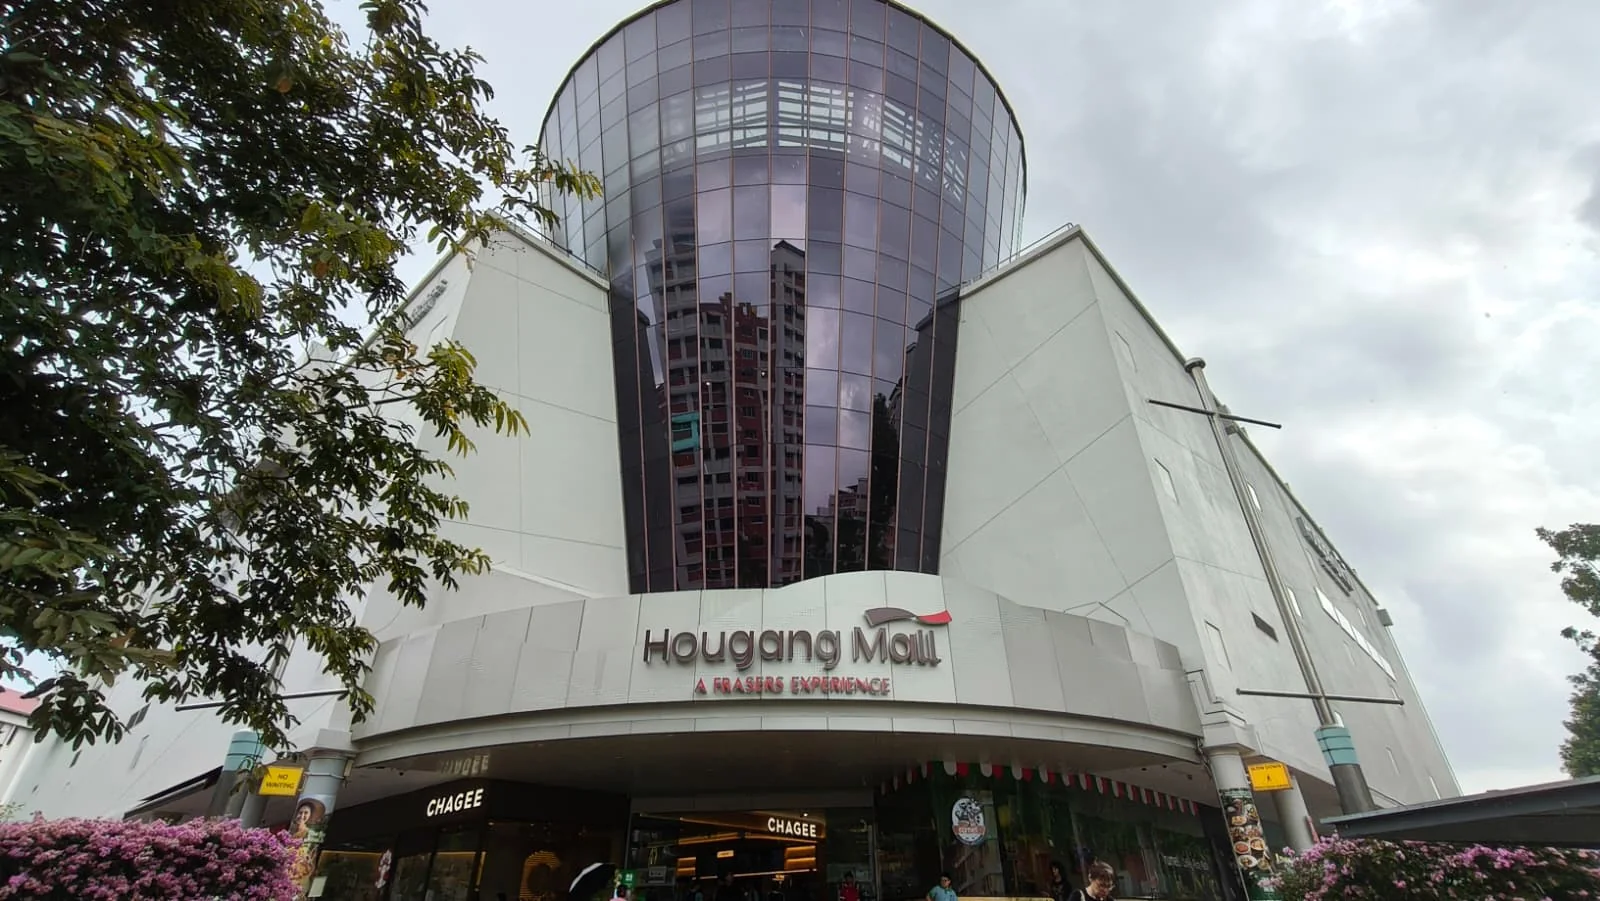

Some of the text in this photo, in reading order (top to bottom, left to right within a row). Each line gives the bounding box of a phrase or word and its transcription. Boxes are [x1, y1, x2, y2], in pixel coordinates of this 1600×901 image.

[643, 626, 942, 670] Hougang Mall
[695, 676, 891, 697] A FRASERS EXPERIENCE
[426, 788, 485, 817] CHAGEE
[767, 817, 817, 837] CHAGEE
